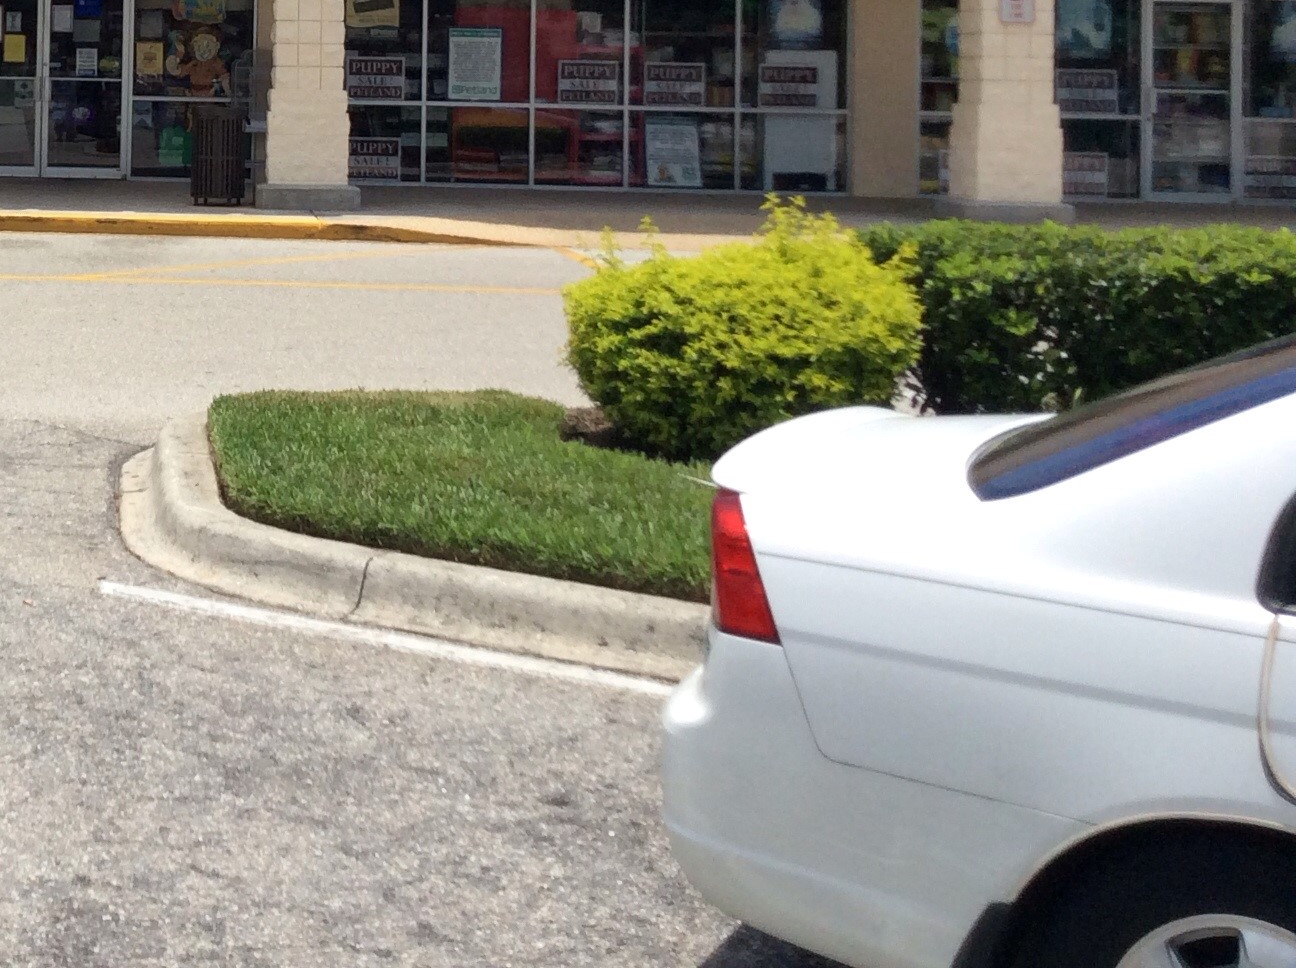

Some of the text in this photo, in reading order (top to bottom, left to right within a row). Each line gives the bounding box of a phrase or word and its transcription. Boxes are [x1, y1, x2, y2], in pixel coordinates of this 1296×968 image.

[351, 62, 400, 73] PUPPY
[563, 65, 612, 77] PUPPY
[350, 87, 401, 97] PETLAND
[349, 142, 394, 154] PUPPY
